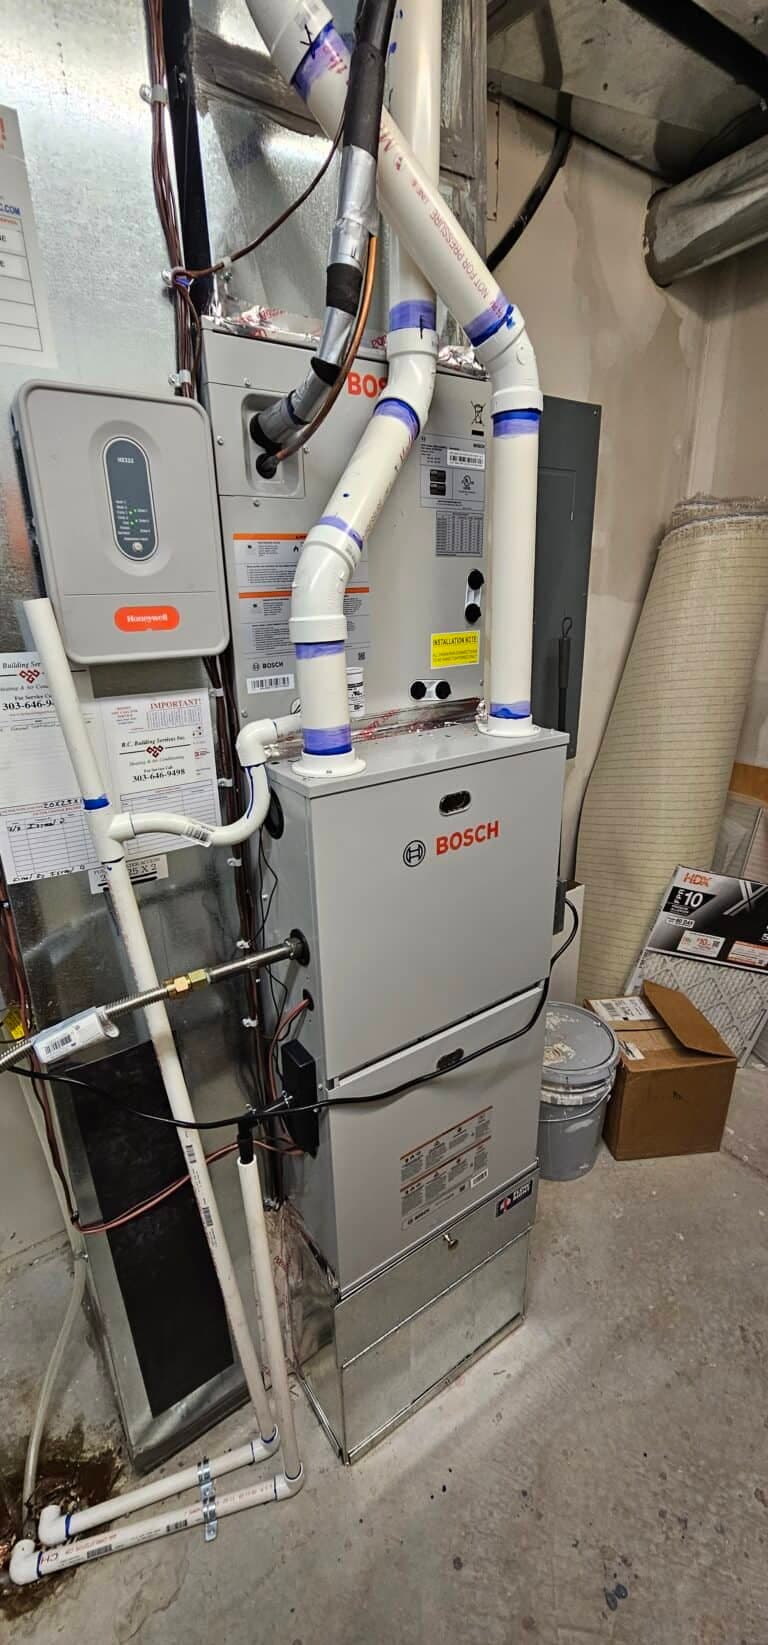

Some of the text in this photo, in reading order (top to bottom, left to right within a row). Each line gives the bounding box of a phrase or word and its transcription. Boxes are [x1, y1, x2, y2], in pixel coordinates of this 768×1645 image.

[429, 208, 465, 261] PRESSURE
[463, 261, 478, 281] FOR
[473, 279, 488, 299] NOT
[126, 613, 168, 624] Honeywell
[433, 635, 478, 646] INSTALLATION NOTE
[262, 661, 283, 669] BOSCH
[150, 698, 200, 709] IMPORTANT!
[132, 768, 186, 783] 303-646-9498
[436, 820, 499, 856] BOSCH
[683, 872, 712, 888] HDX
[684, 891, 703, 907] 10
